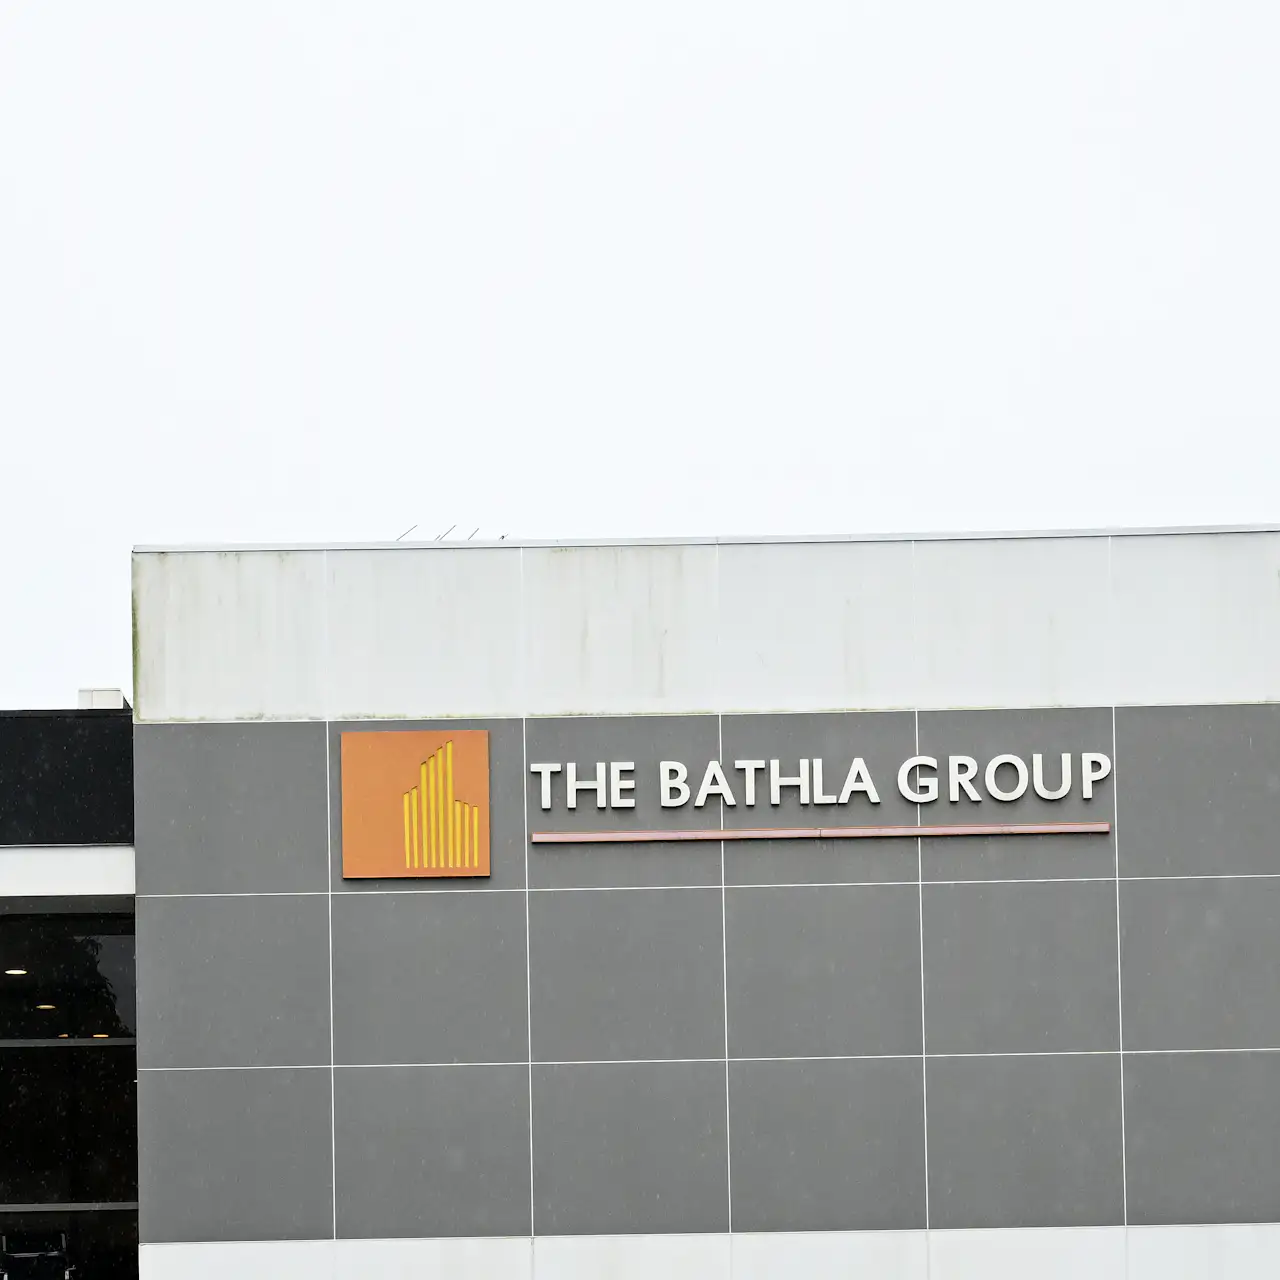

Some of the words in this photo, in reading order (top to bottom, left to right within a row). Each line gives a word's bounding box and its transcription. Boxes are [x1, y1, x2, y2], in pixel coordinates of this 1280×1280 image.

[530, 761, 636, 810] THE
[659, 756, 881, 808] BATHLA
[896, 752, 1112, 804] GROUP
